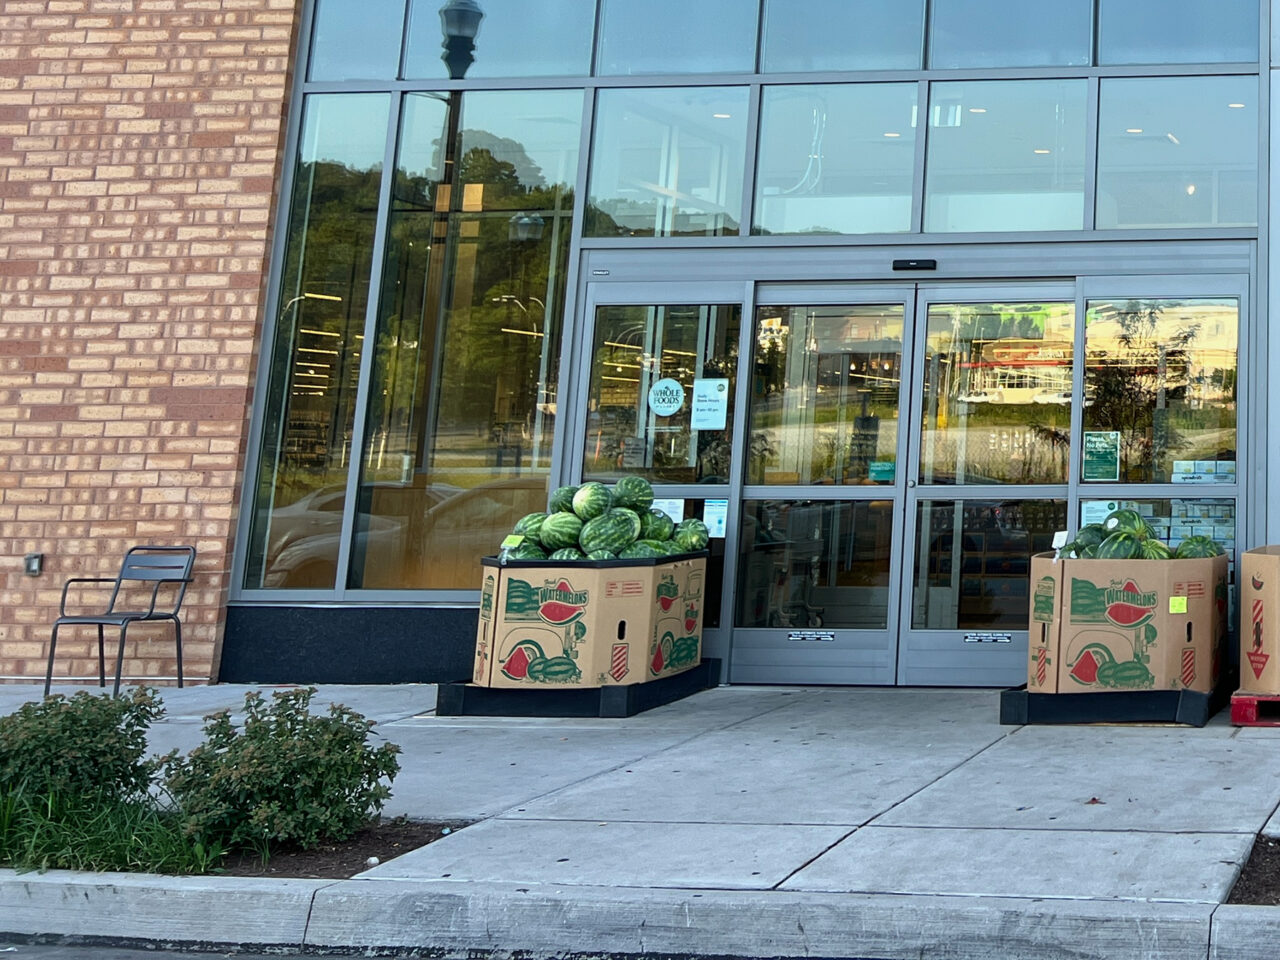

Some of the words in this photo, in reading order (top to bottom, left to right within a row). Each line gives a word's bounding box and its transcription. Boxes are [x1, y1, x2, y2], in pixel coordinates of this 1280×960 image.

[652, 386, 681, 397] WHOLE
[653, 396, 680, 405] FOODS
[539, 589, 588, 605] WATERMELONS
[1106, 590, 1156, 606] WATERMELONS
